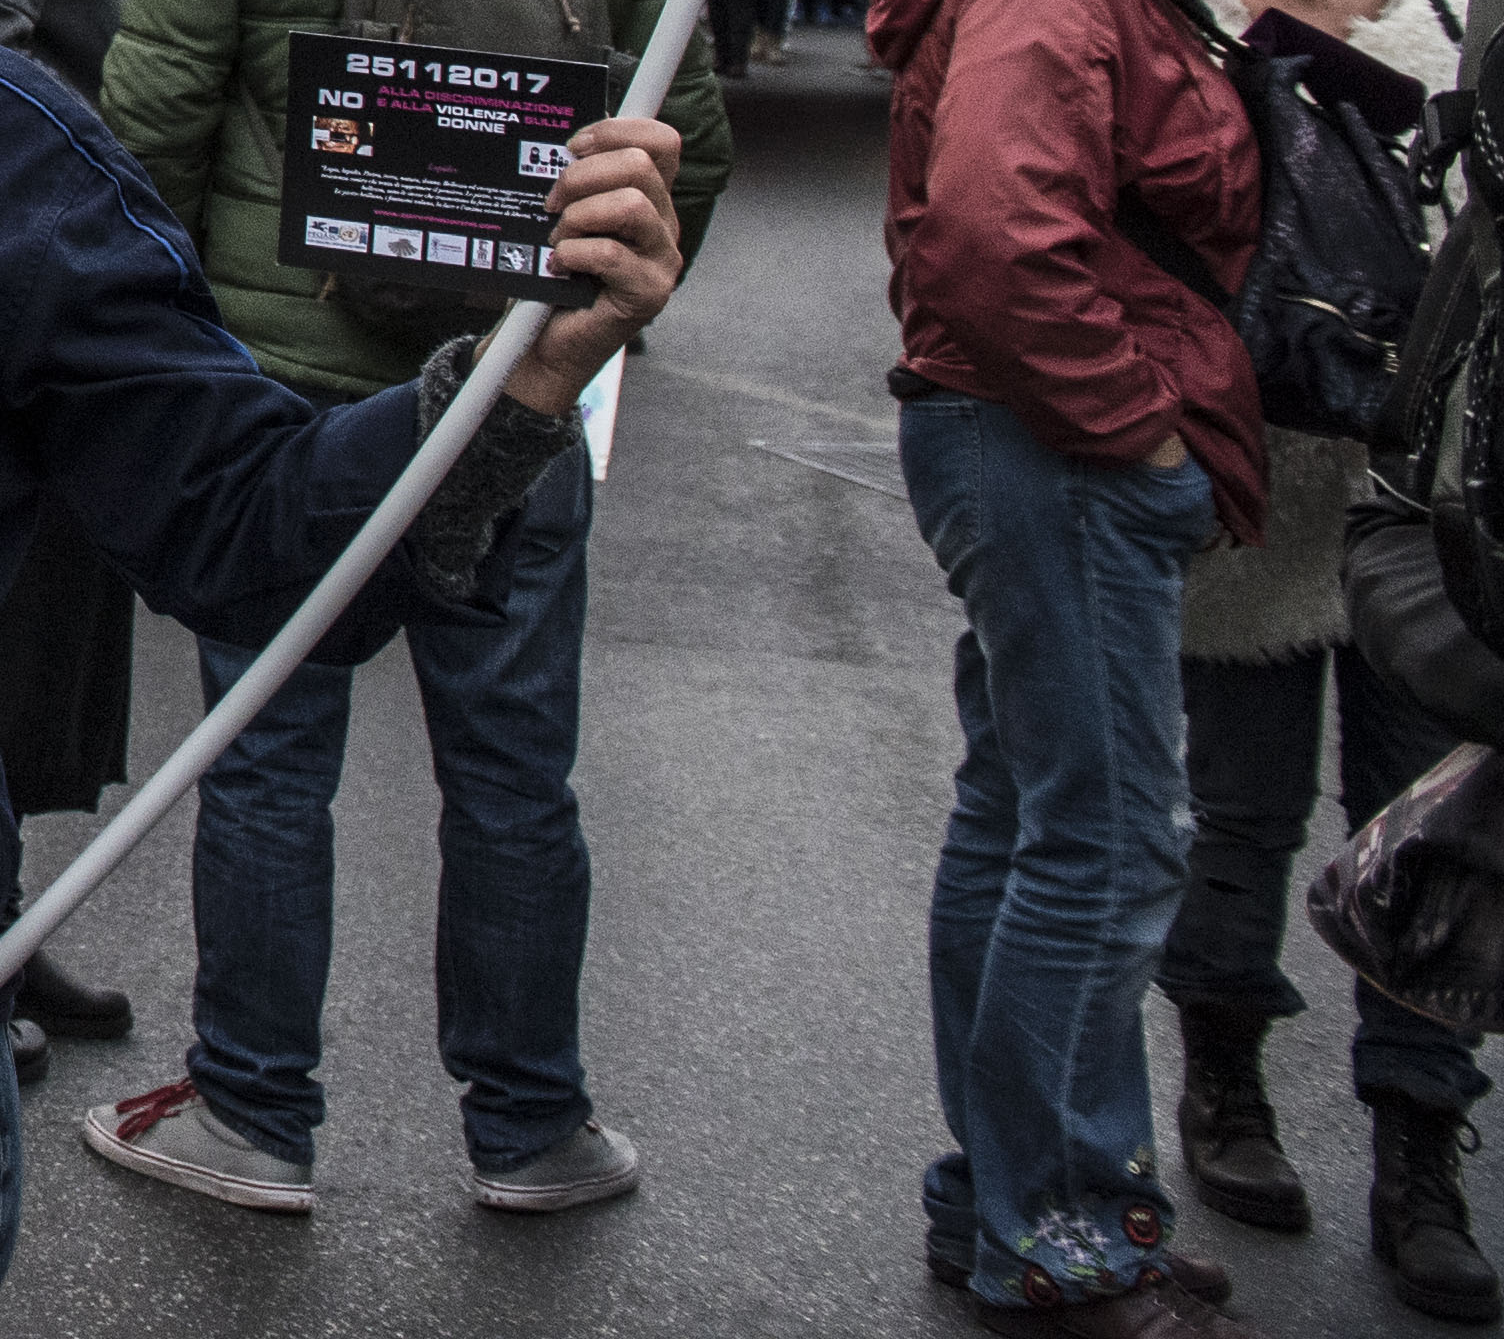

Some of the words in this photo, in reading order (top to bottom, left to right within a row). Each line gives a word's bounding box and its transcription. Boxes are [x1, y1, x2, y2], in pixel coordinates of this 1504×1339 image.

[345, 53, 551, 95] 25112017
[317, 88, 365, 110] NO
[376, 97, 385, 108] E
[390, 99, 434, 113] ALLA
[436, 104, 520, 124] VIOLENZA
[524, 114, 571, 130] SULLE
[377, 85, 422, 100] ALLA
[424, 90, 576, 118] DISCRIMINAZIONE
[436, 118, 506, 135] DONNE
